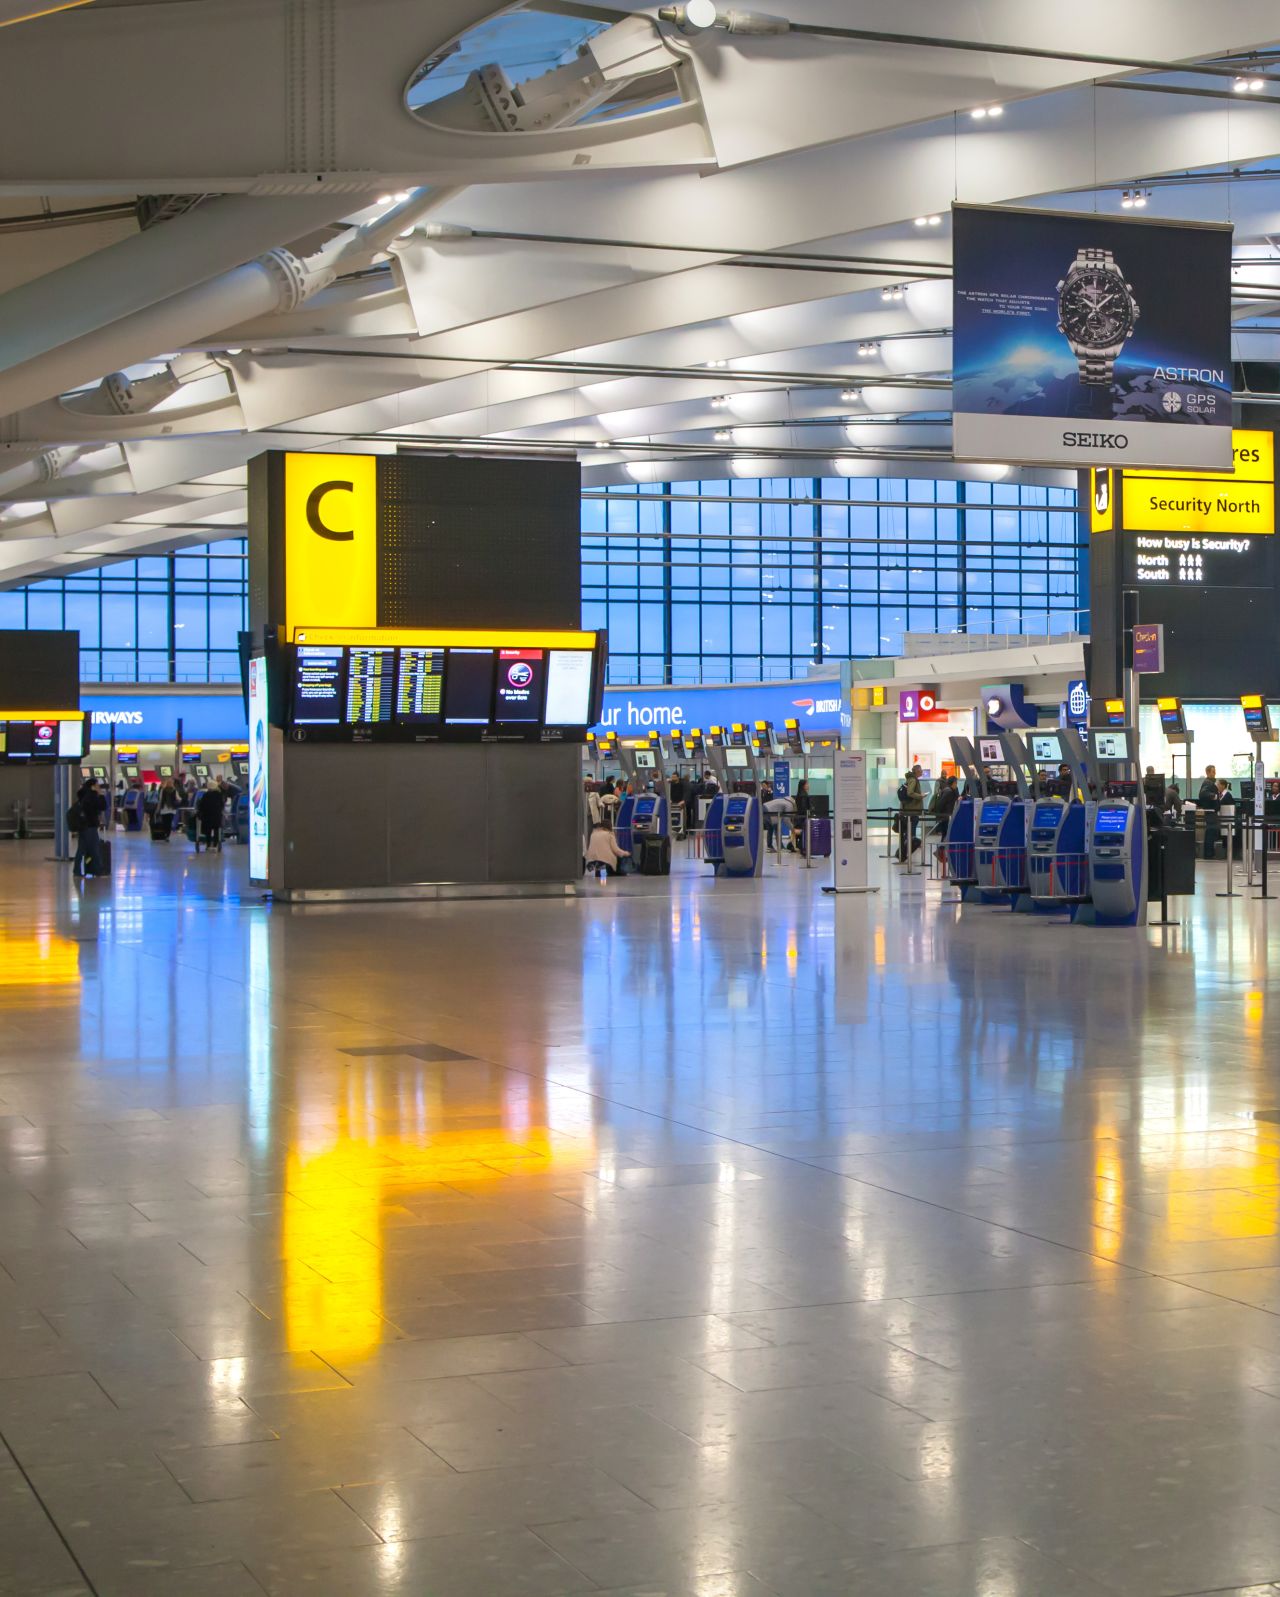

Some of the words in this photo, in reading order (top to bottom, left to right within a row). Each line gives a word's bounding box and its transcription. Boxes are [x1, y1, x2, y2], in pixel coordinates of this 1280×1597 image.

[1153, 366, 1224, 384] ASTRON
[1186, 393, 1216, 405] GPS
[1187, 405, 1216, 414] SOLAR
[1062, 431, 1129, 449] SEIKO
[1232, 448, 1260, 462] res
[305, 480, 355, 541] C
[1150, 496, 1212, 515] Security
[1216, 498, 1260, 513] North
[1137, 537, 1163, 549] How
[1165, 537, 1190, 551] busy
[1191, 537, 1201, 549] is
[1202, 538, 1250, 552] Security?
[1137, 554, 1169, 566] North
[1137, 569, 1170, 580] South
[815, 698, 838, 713] BRITISH
[91, 711, 143, 724] IRWAYS
[601, 707, 622, 726] ur
[627, 701, 687, 726] home.
